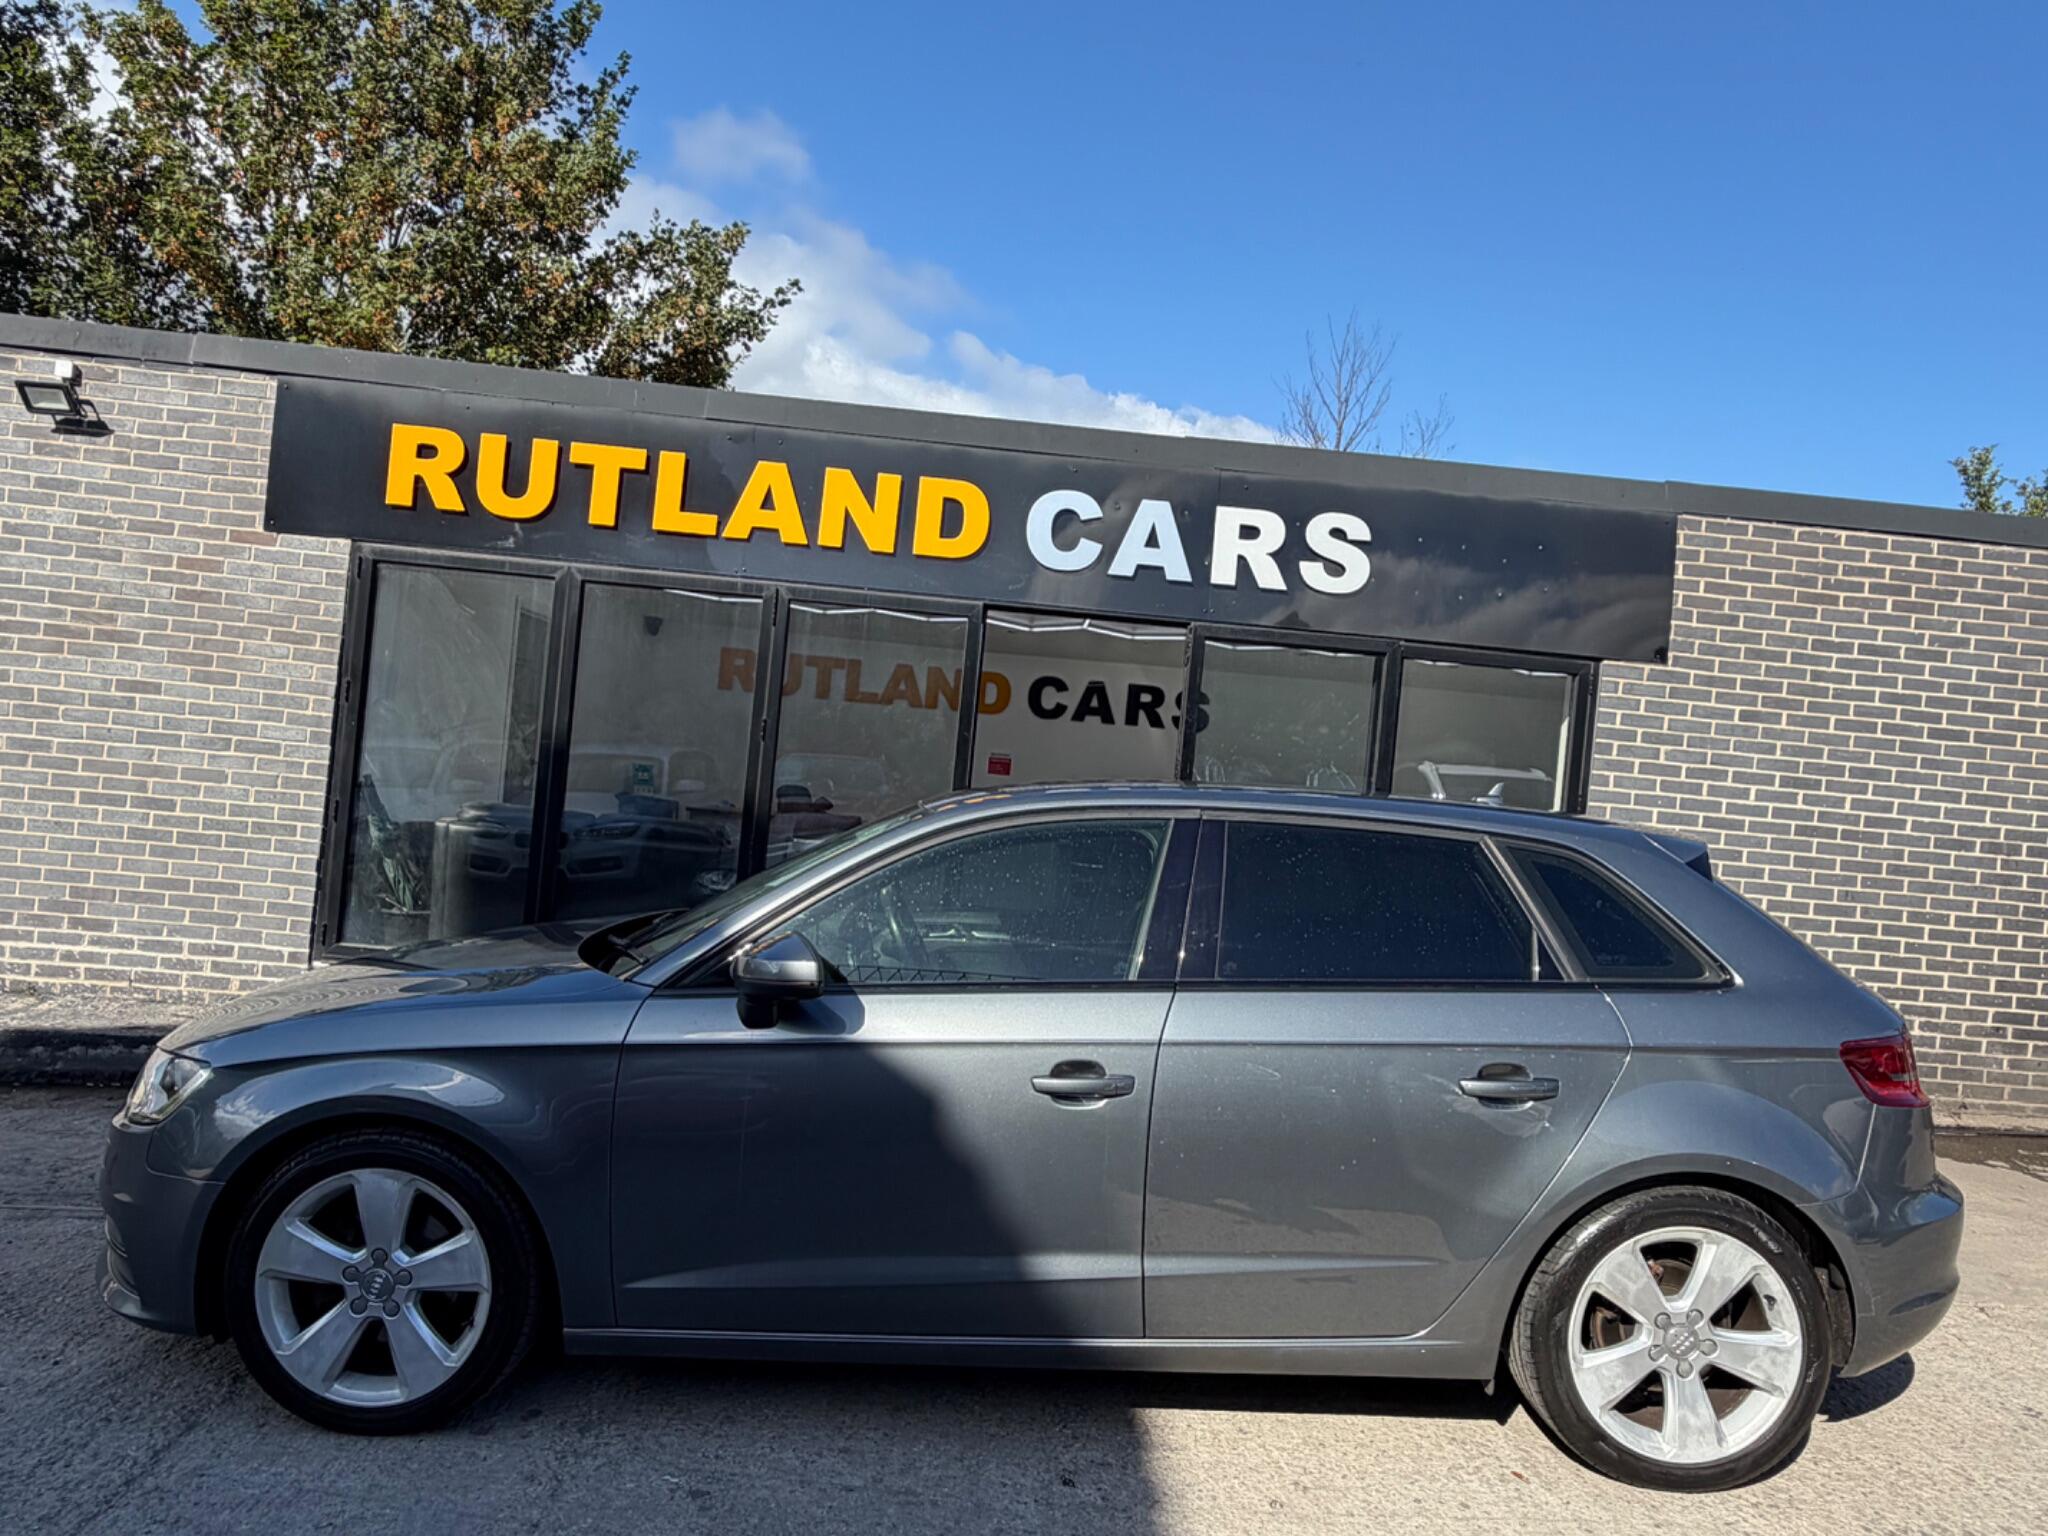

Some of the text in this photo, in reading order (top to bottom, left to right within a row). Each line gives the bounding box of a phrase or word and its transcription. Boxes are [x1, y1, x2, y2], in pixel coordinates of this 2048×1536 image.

[385, 423, 1372, 595] RUTLAND CARS
[1028, 675, 1210, 734] CARS
